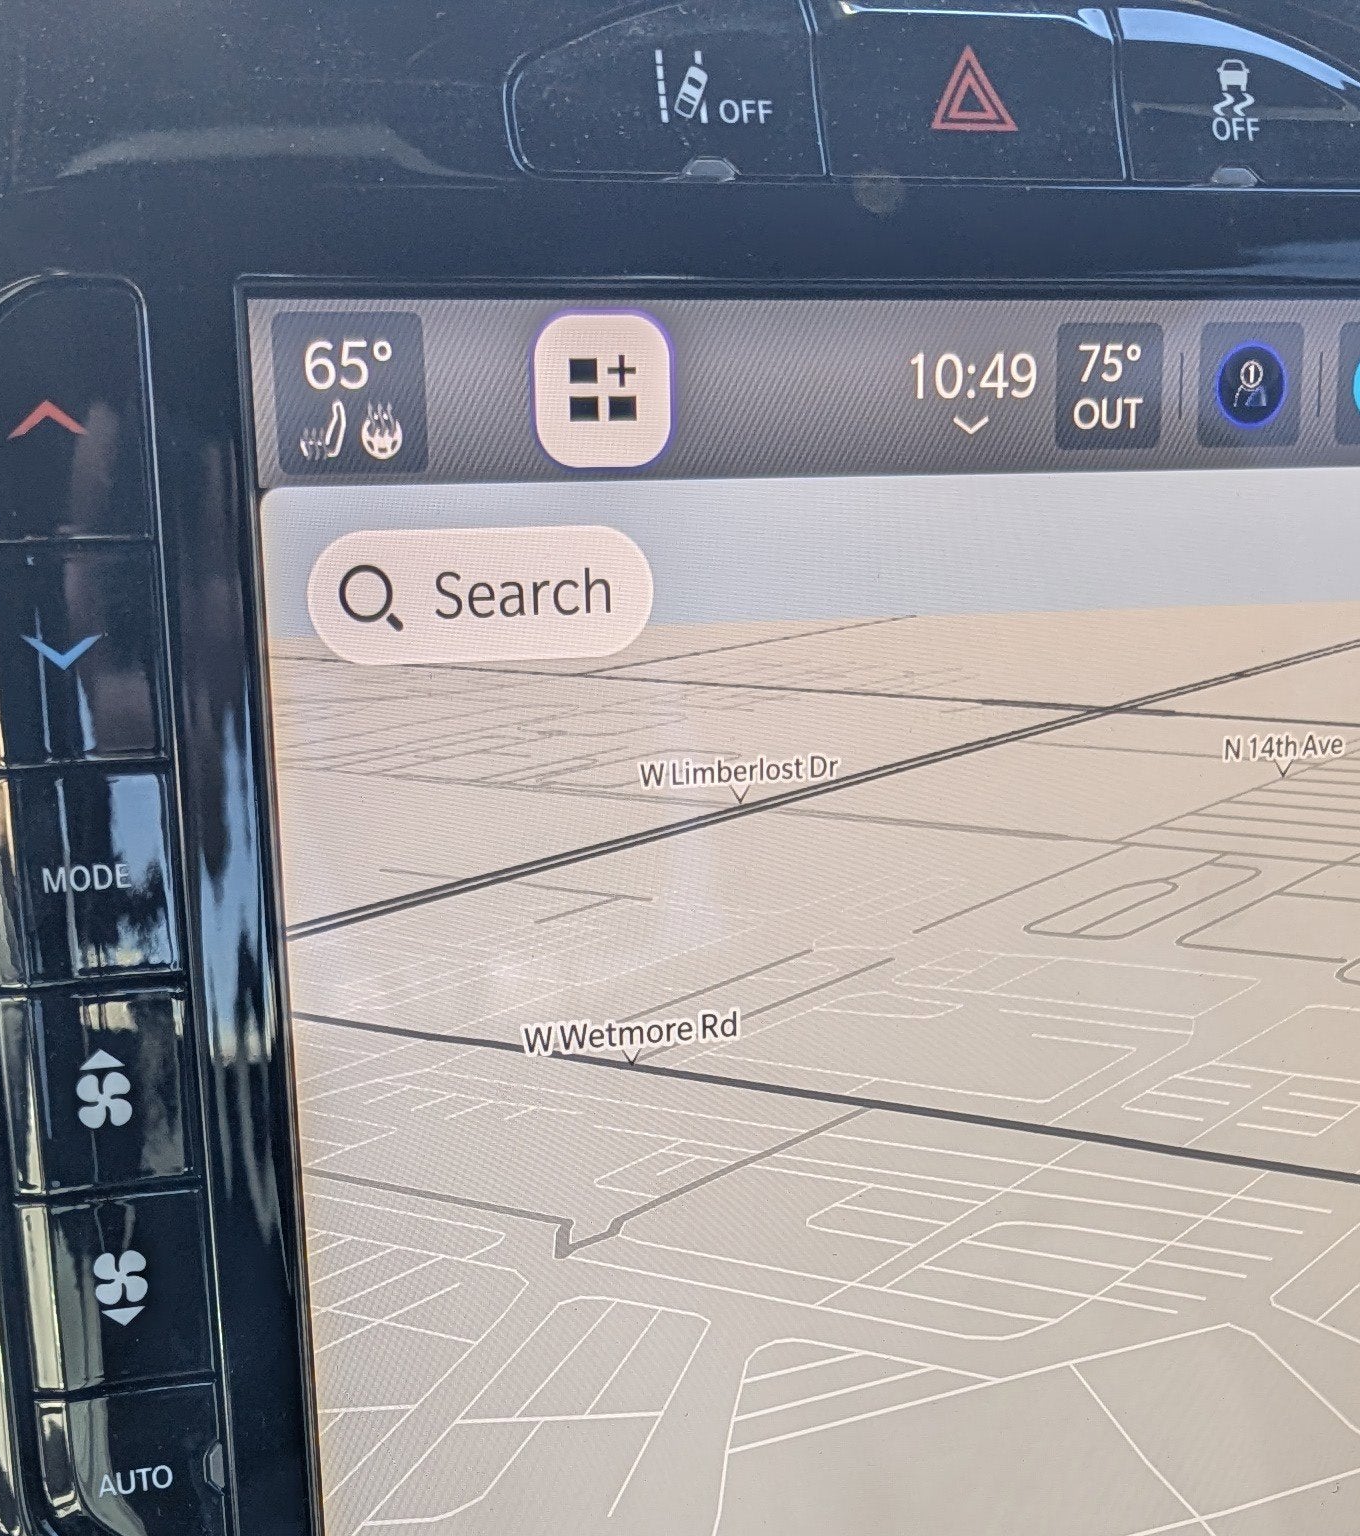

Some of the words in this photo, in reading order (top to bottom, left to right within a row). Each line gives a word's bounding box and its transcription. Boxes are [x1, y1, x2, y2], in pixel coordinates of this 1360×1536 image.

[718, 99, 773, 124] OFF
[1212, 117, 1260, 141] OFF
[304, 339, 393, 390] 65°
[907, 351, 1038, 401] 10:49
[1079, 343, 1142, 385] 75°
[1073, 397, 1143, 431] OUT
[434, 566, 613, 620] Search
[1224, 737, 1240, 761] N
[1249, 736, 1297, 759] 14th
[1303, 735, 1343, 757] Ave
[640, 763, 664, 788] W
[672, 757, 803, 786] Limberlost
[810, 755, 839, 779] Dr
[42, 863, 132, 894] MODE
[524, 1027, 552, 1053] W
[560, 1021, 694, 1051] Wetmore
[702, 1011, 739, 1040] Rd
[99, 1465, 174, 1497] AUTO
